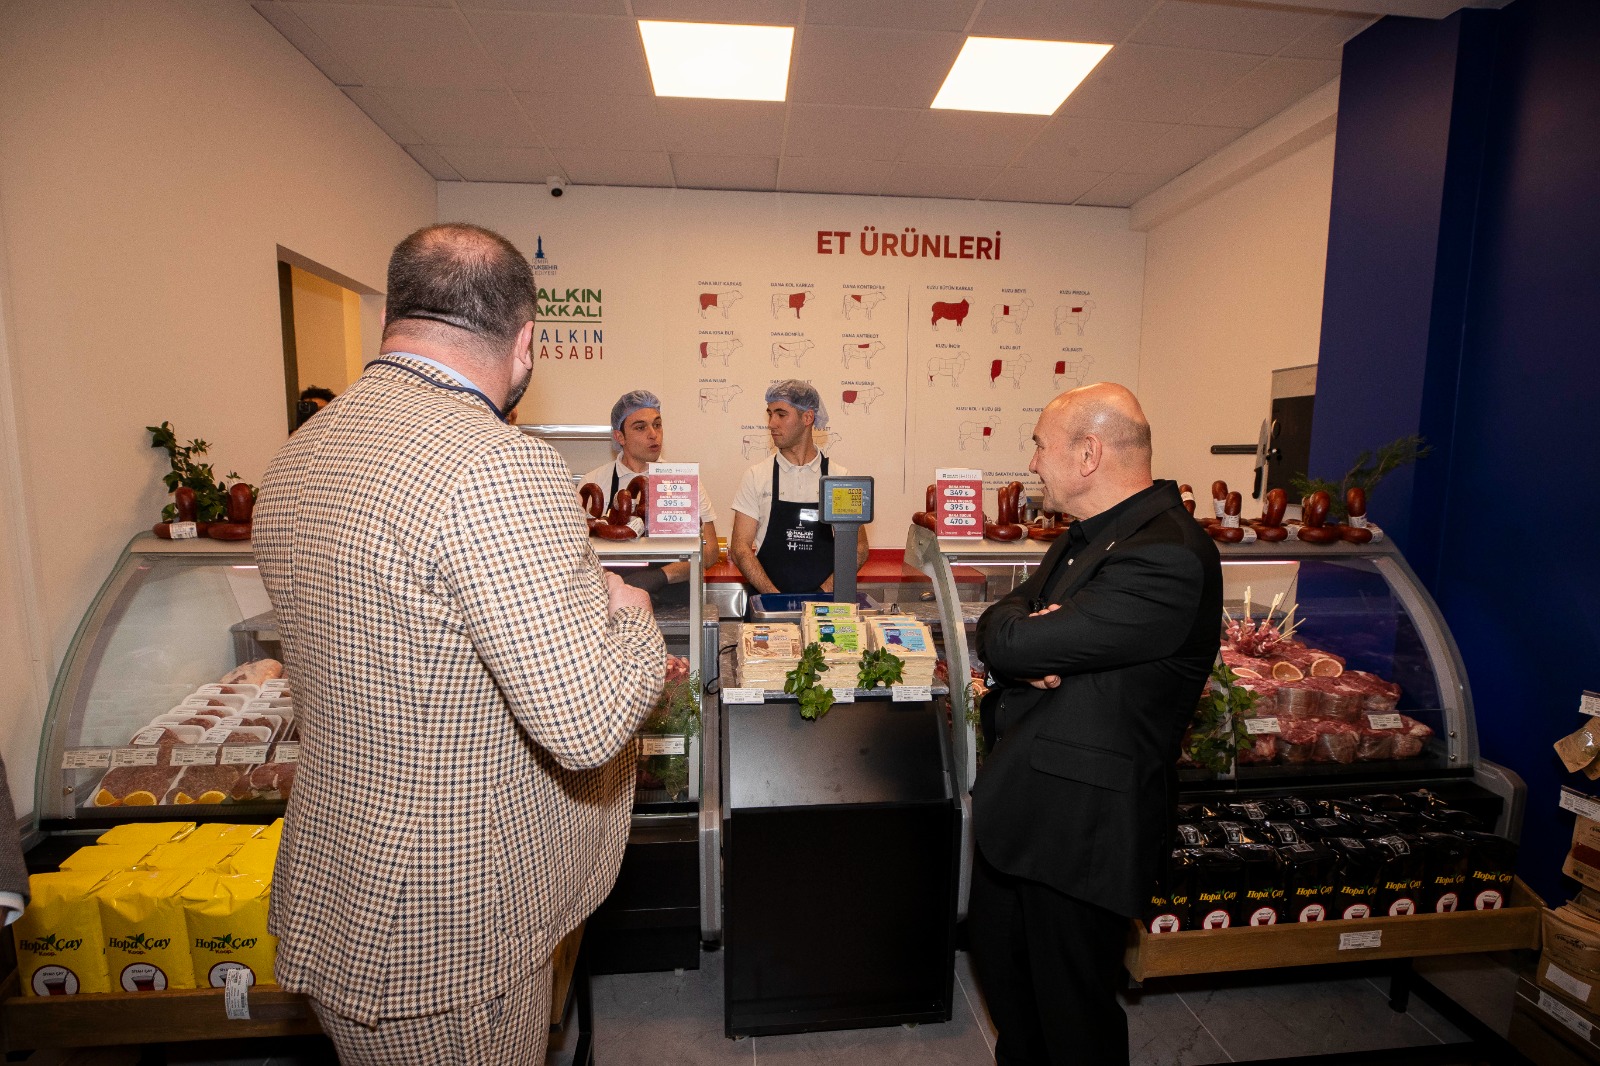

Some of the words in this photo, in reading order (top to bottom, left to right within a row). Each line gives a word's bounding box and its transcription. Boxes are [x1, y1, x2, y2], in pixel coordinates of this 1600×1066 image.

[817, 231, 851, 254] ET
[860, 226, 1001, 260] ÜRÜNLERİ
[537, 288, 602, 303] ALKIN
[536, 304, 602, 317] AKKALI
[540, 329, 603, 343] ALKIN
[540, 345, 603, 360] ASABI
[1434, 876, 1454, 885] Hopa
[1472, 871, 1496, 881] Hopa
[1499, 873, 1512, 883] Çay
[1296, 887, 1317, 897] Hopa
[1320, 886, 1333, 895] Çay
[1340, 886, 1364, 896] Hopa
[1385, 881, 1406, 891] Hopa
[1410, 880, 1422, 889] Çay
[1173, 896, 1188, 905] Çay
[1199, 893, 1221, 902] Hopa
[1224, 891, 1237, 900] Çay
[1246, 890, 1269, 900] Hopa
[1271, 889, 1285, 899] Çay
[20, 939, 49, 953] Hopa
[55, 938, 83, 952] Çay
[109, 938, 139, 952] Hopa
[145, 938, 171, 951] Çay
[195, 938, 226, 952] Hopa
[232, 937, 258, 950] Çay
